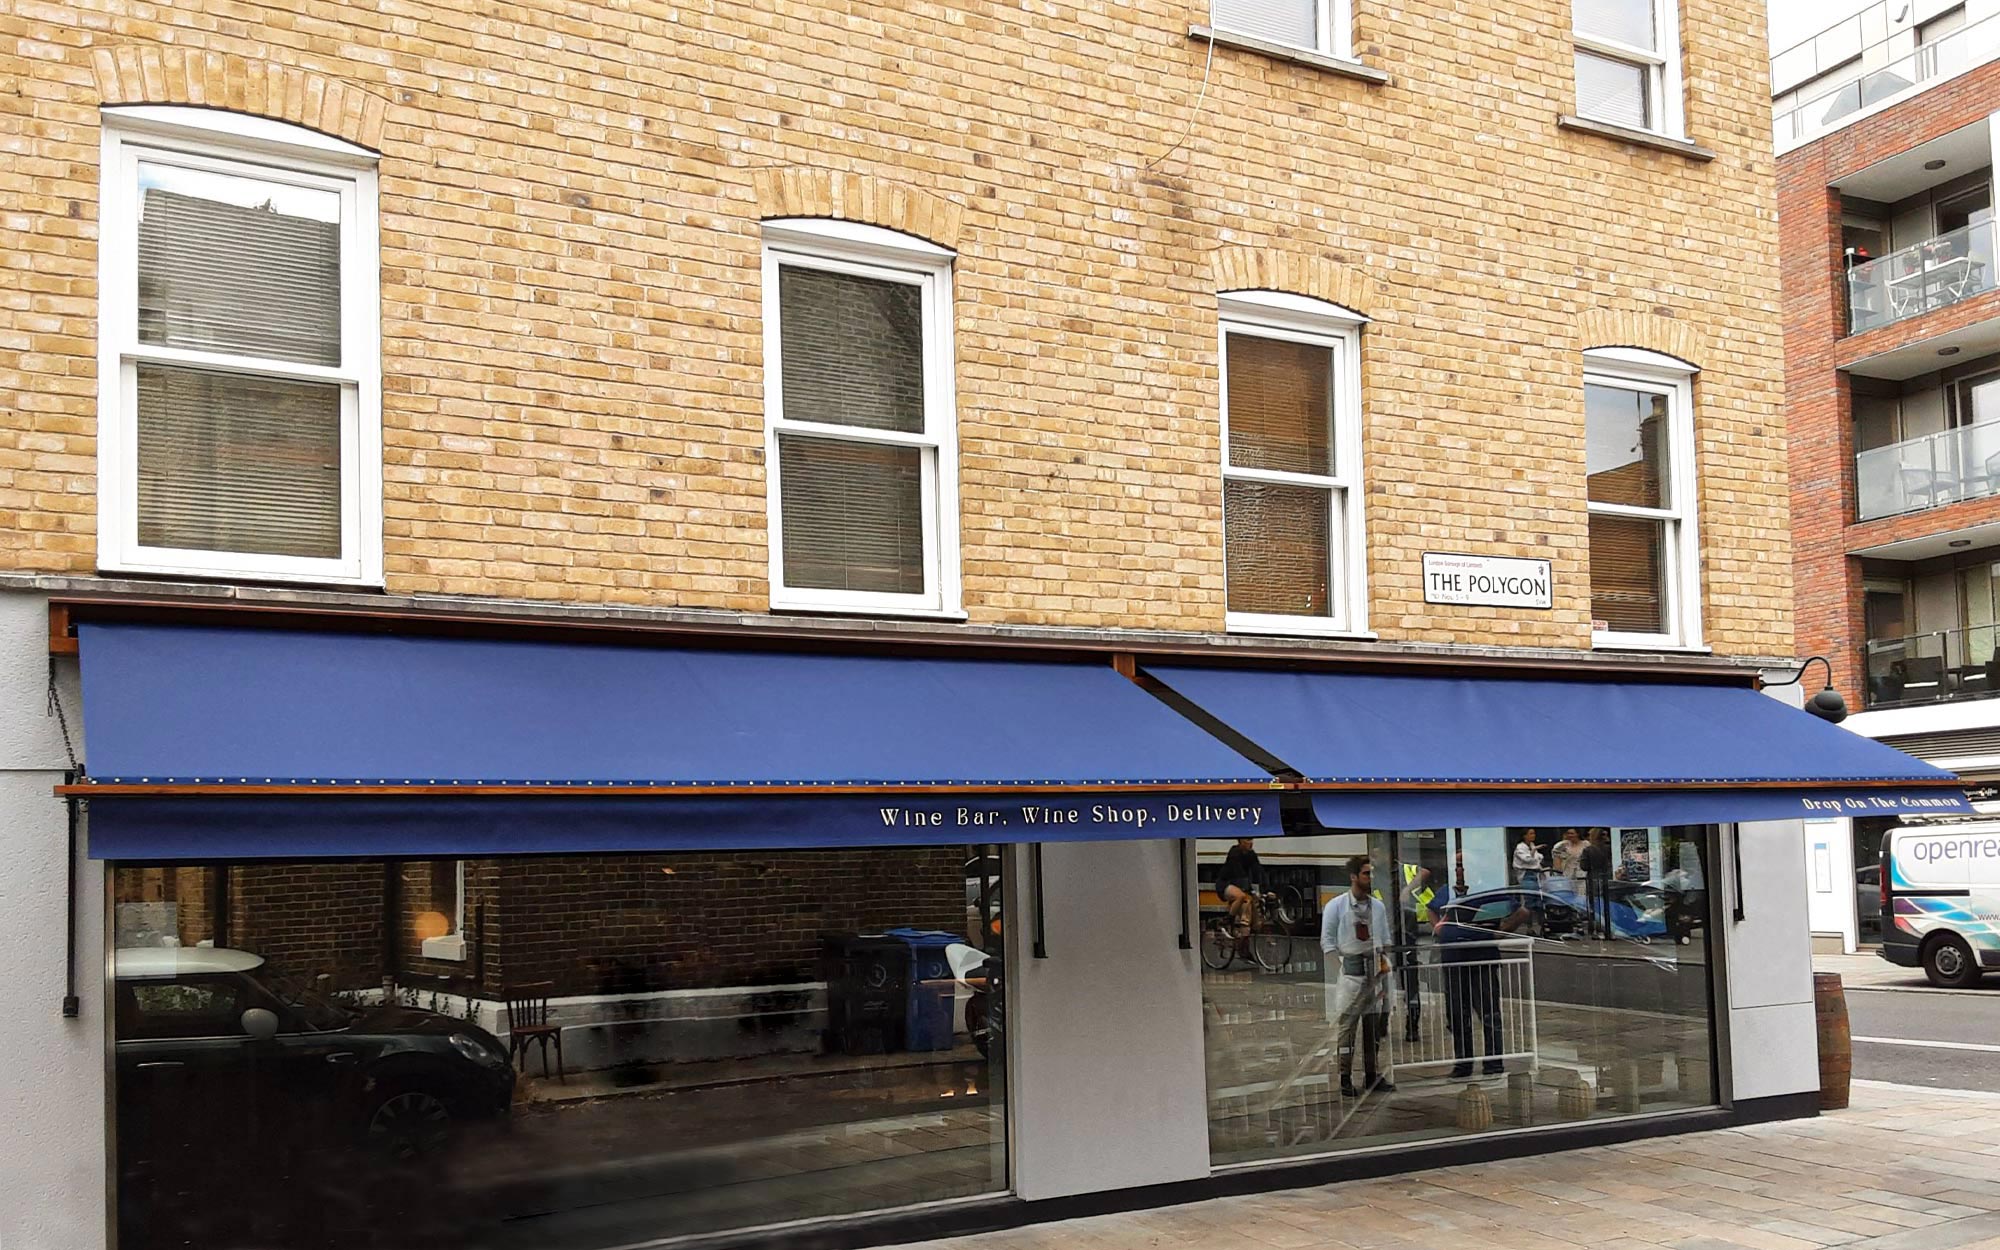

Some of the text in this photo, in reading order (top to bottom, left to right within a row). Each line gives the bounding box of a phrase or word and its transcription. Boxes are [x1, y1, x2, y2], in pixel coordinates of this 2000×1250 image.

[1430, 573, 1546, 595] THE POLYGON
[881, 808, 942, 825] Wine
[1022, 807, 1078, 824] Wine
[1168, 804, 1262, 825] Delivery
[1802, 796, 1961, 812] Drop On The Common
